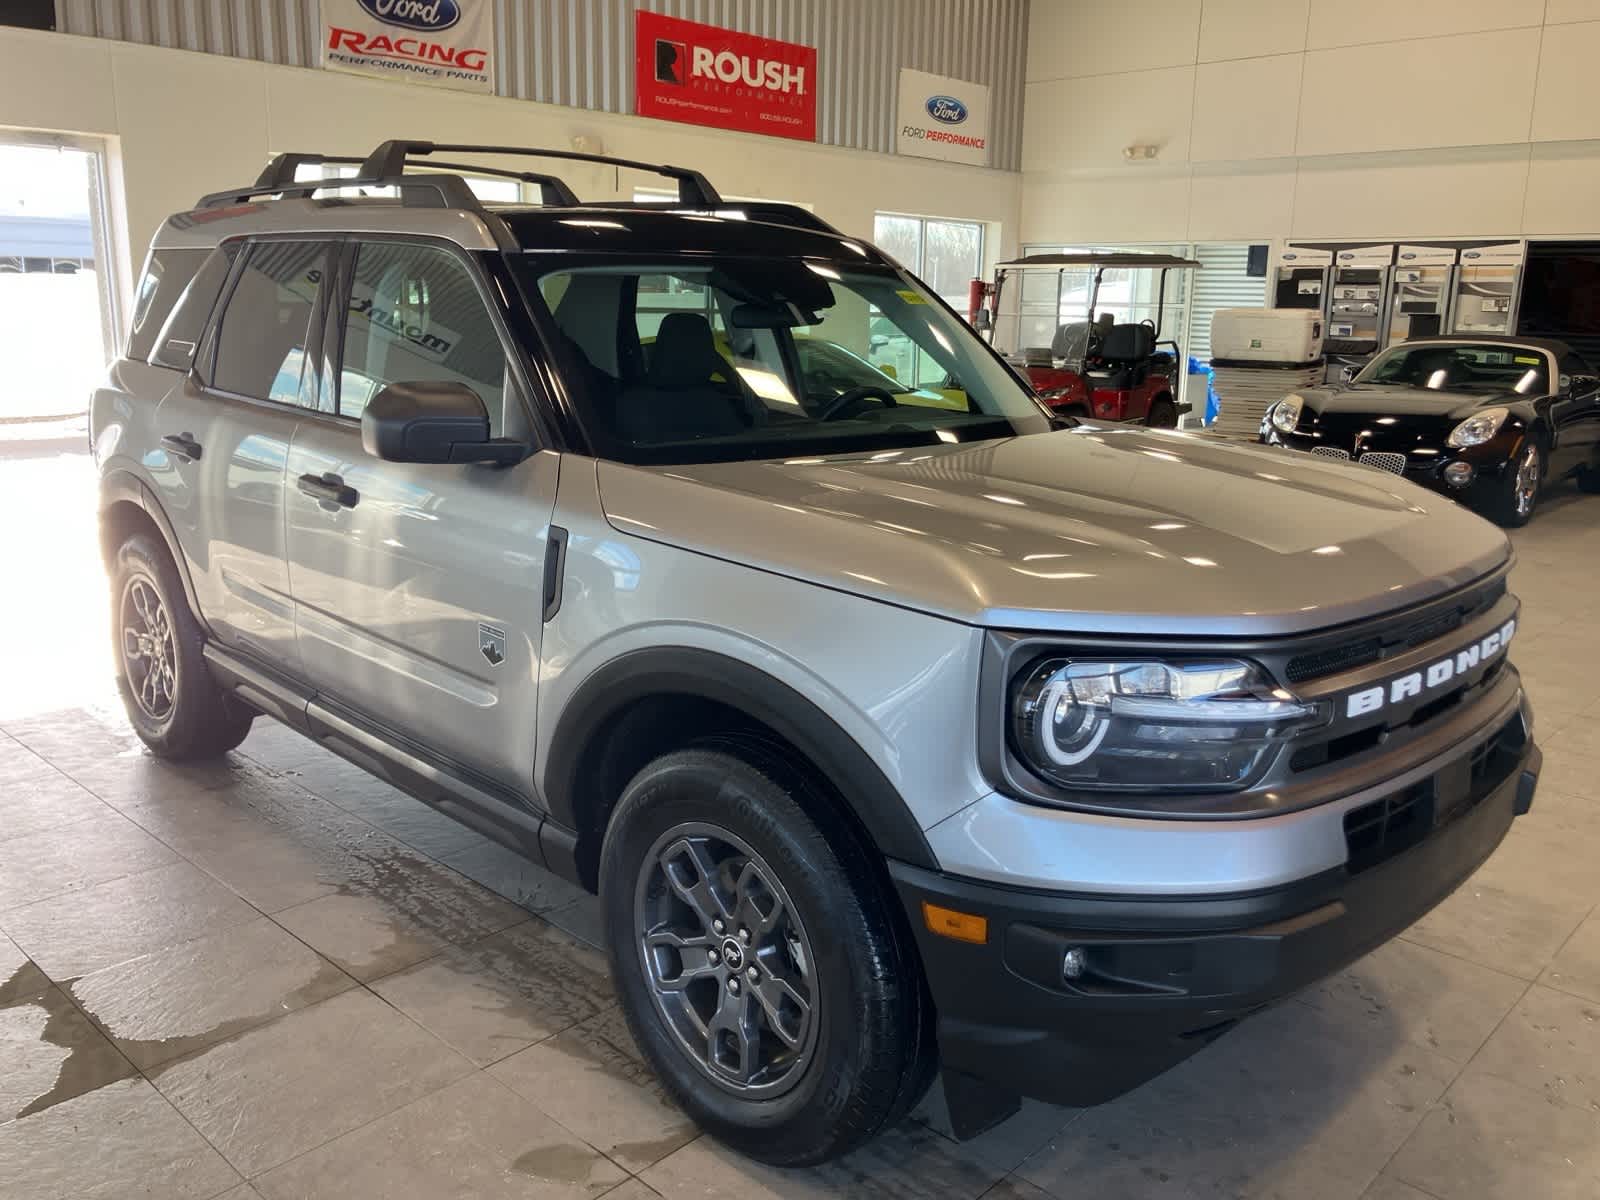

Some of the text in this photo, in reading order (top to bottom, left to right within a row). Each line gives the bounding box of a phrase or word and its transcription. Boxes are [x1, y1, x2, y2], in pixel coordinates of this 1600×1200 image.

[328, 25, 487, 71] RACING
[329, 52, 488, 83] PERFORMANCE PARTS
[692, 46, 805, 95] ROUSH
[933, 98, 960, 121] Ford
[902, 126, 986, 149] FORD PERFORMANCE
[1347, 619, 1516, 718] BRONCO
